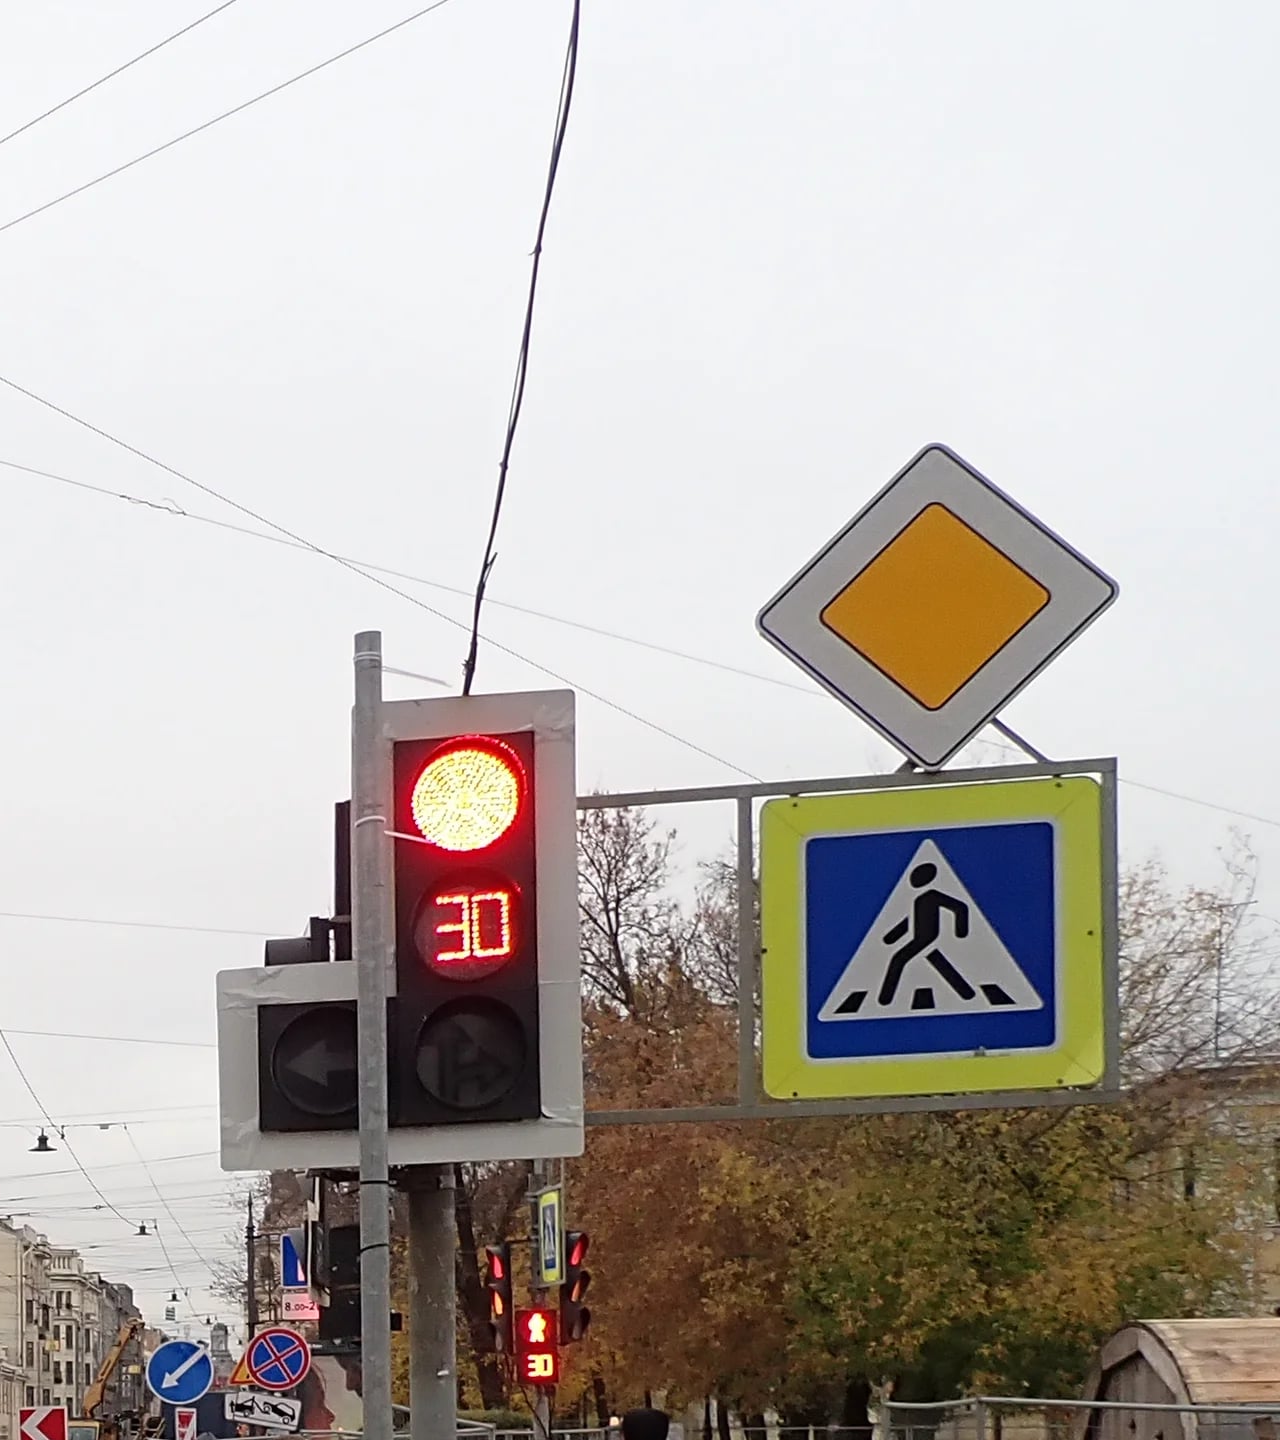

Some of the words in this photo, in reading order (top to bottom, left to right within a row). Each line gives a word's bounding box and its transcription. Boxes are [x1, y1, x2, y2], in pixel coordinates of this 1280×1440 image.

[436, 891, 510, 961] 30
[284, 1301, 318, 1312] 8.00-2
[527, 1354, 554, 1377] 30
